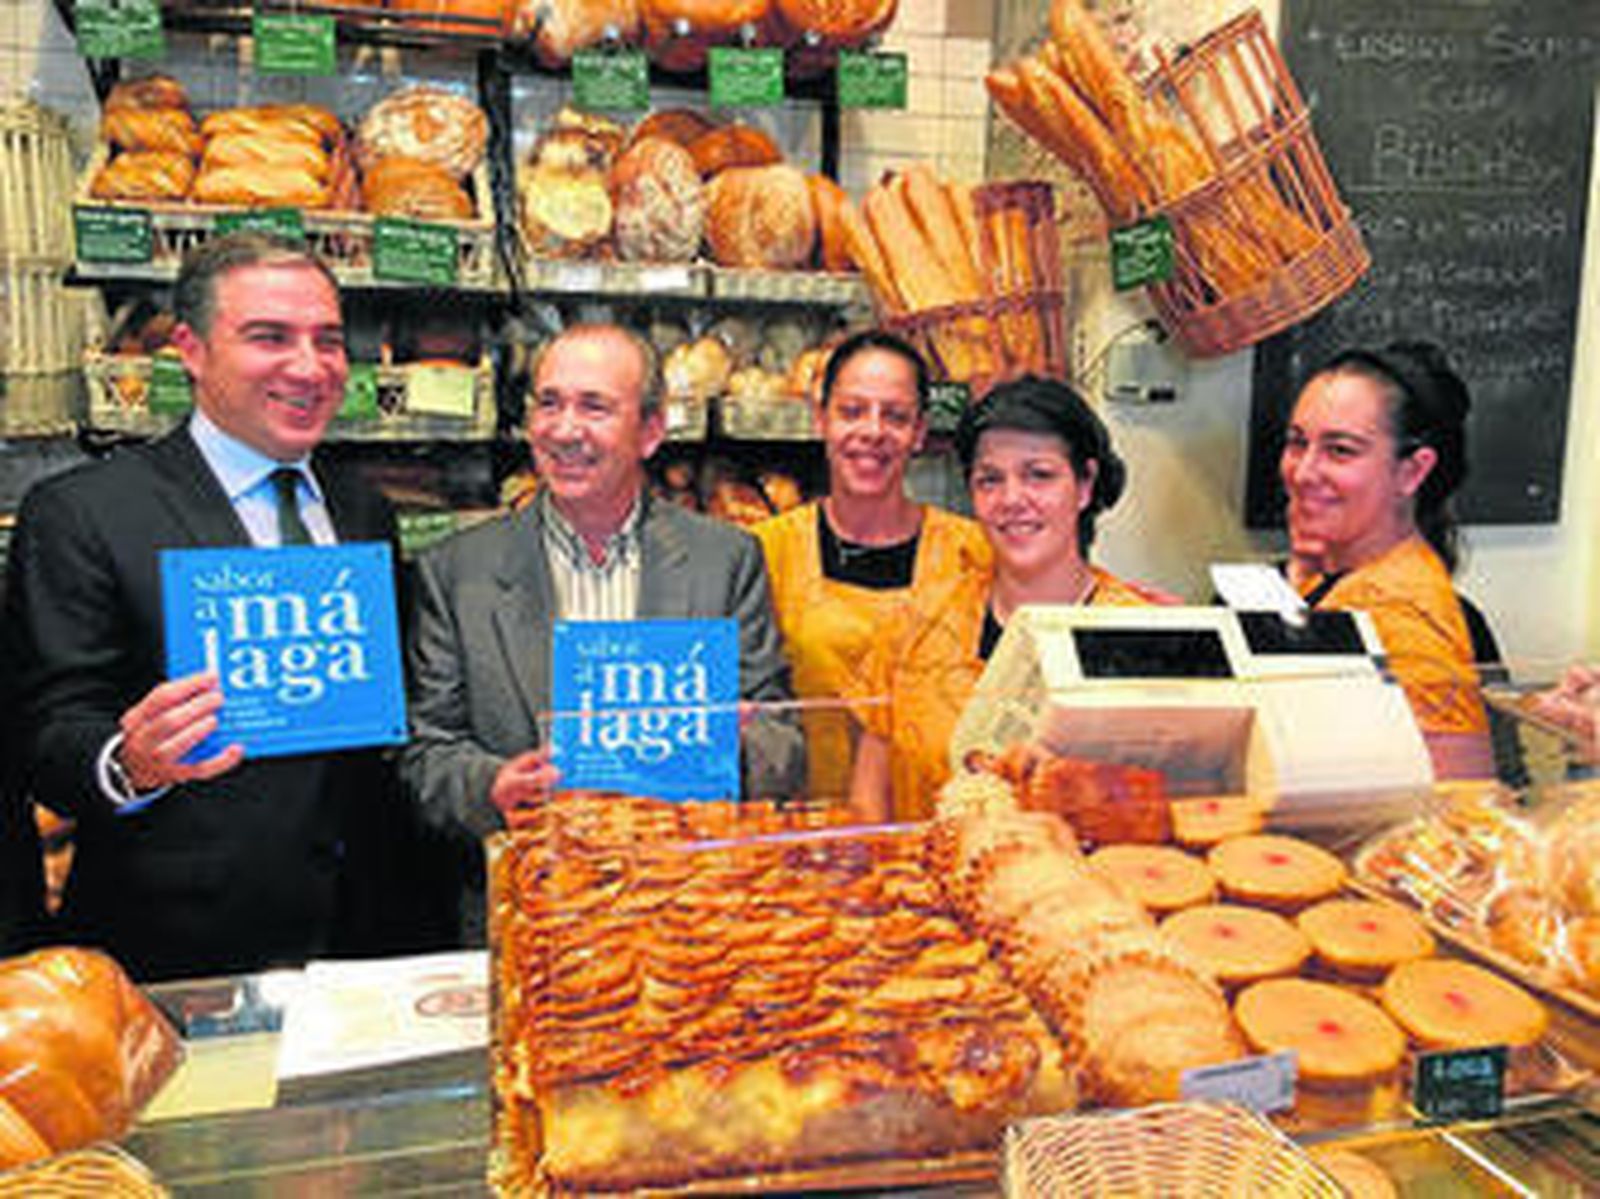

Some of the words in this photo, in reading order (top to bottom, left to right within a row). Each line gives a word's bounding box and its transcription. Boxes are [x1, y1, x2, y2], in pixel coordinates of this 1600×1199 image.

[192, 563, 275, 591] sabor
[194, 595, 219, 620] a
[229, 567, 367, 641] má
[204, 627, 372, 705] laga
[602, 642, 709, 703] má
[580, 690, 711, 764] laga
